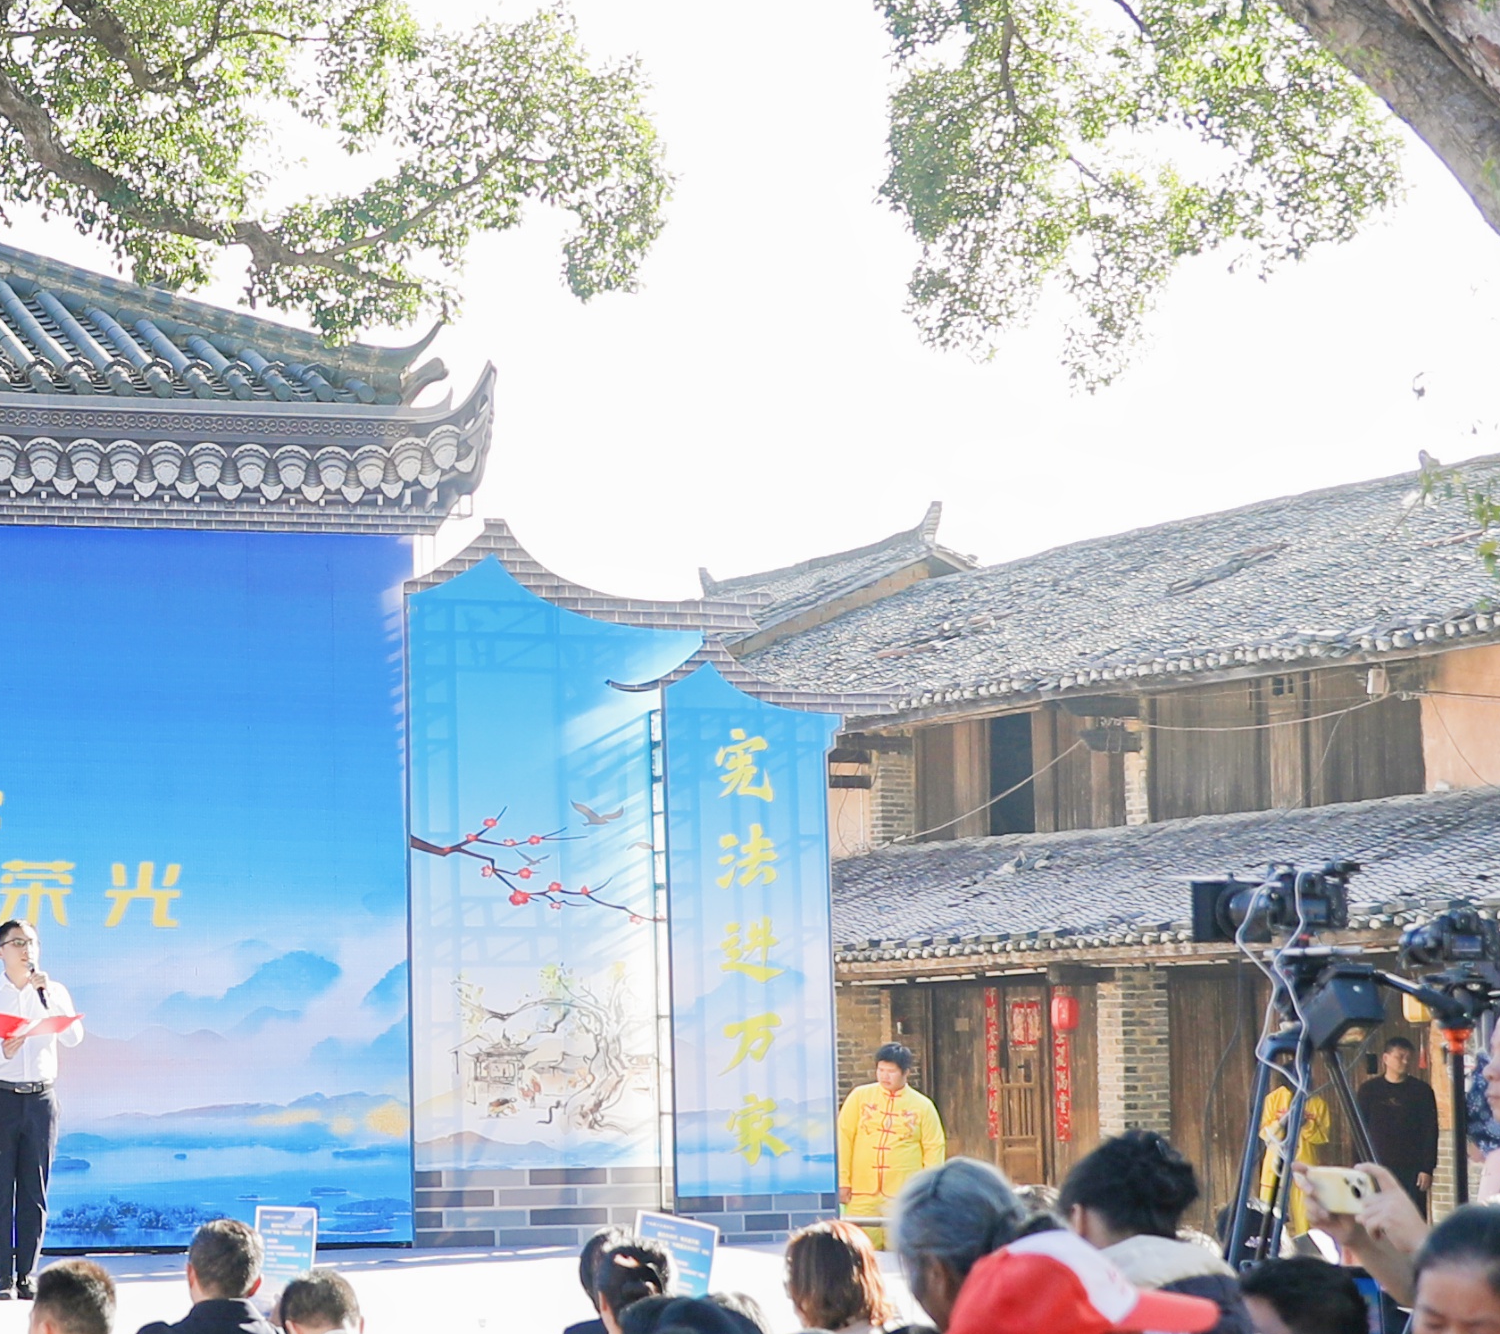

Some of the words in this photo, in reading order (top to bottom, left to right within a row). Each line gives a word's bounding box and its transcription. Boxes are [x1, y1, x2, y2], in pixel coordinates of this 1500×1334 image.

[713, 728, 793, 1165] 宪法进万家
